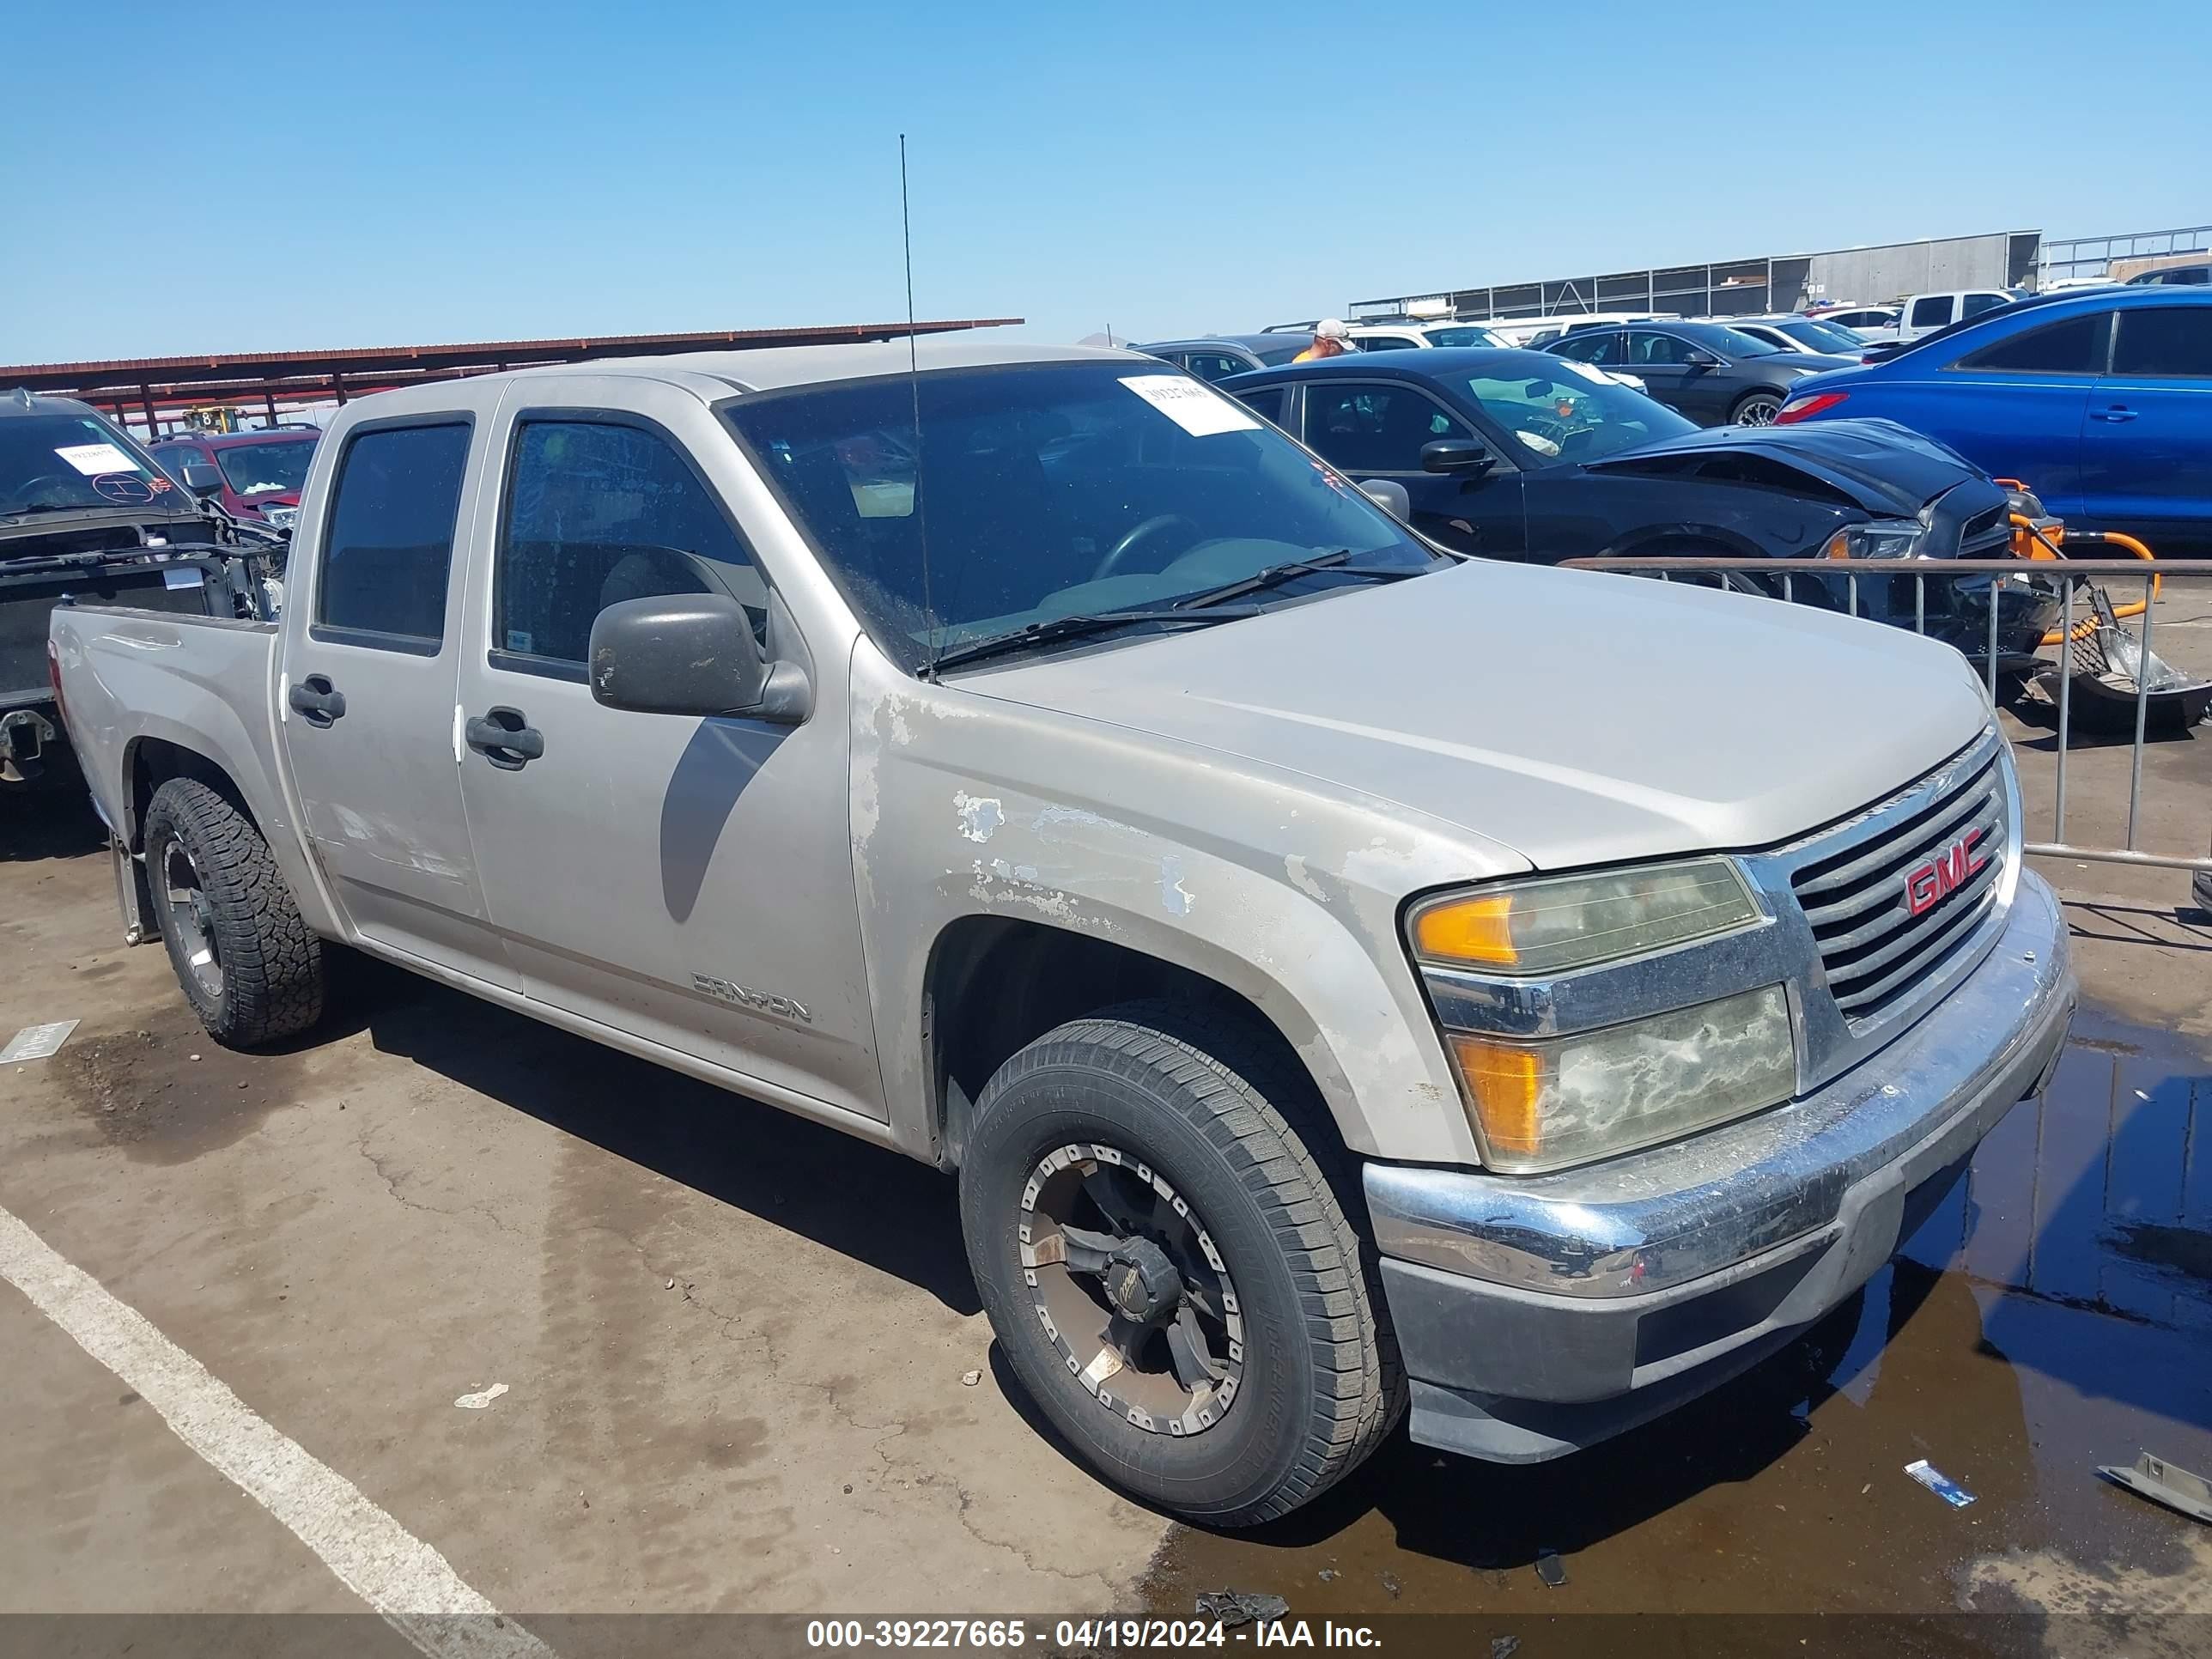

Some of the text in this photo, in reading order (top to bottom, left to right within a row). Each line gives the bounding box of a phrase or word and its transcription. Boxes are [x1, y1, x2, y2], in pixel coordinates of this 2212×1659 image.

[203, 412, 211, 425] 8
[1905, 826, 1985, 917] GMC
[690, 971, 812, 1024] CANYON
[1263, 1318, 1286, 1438] DEFENDER
